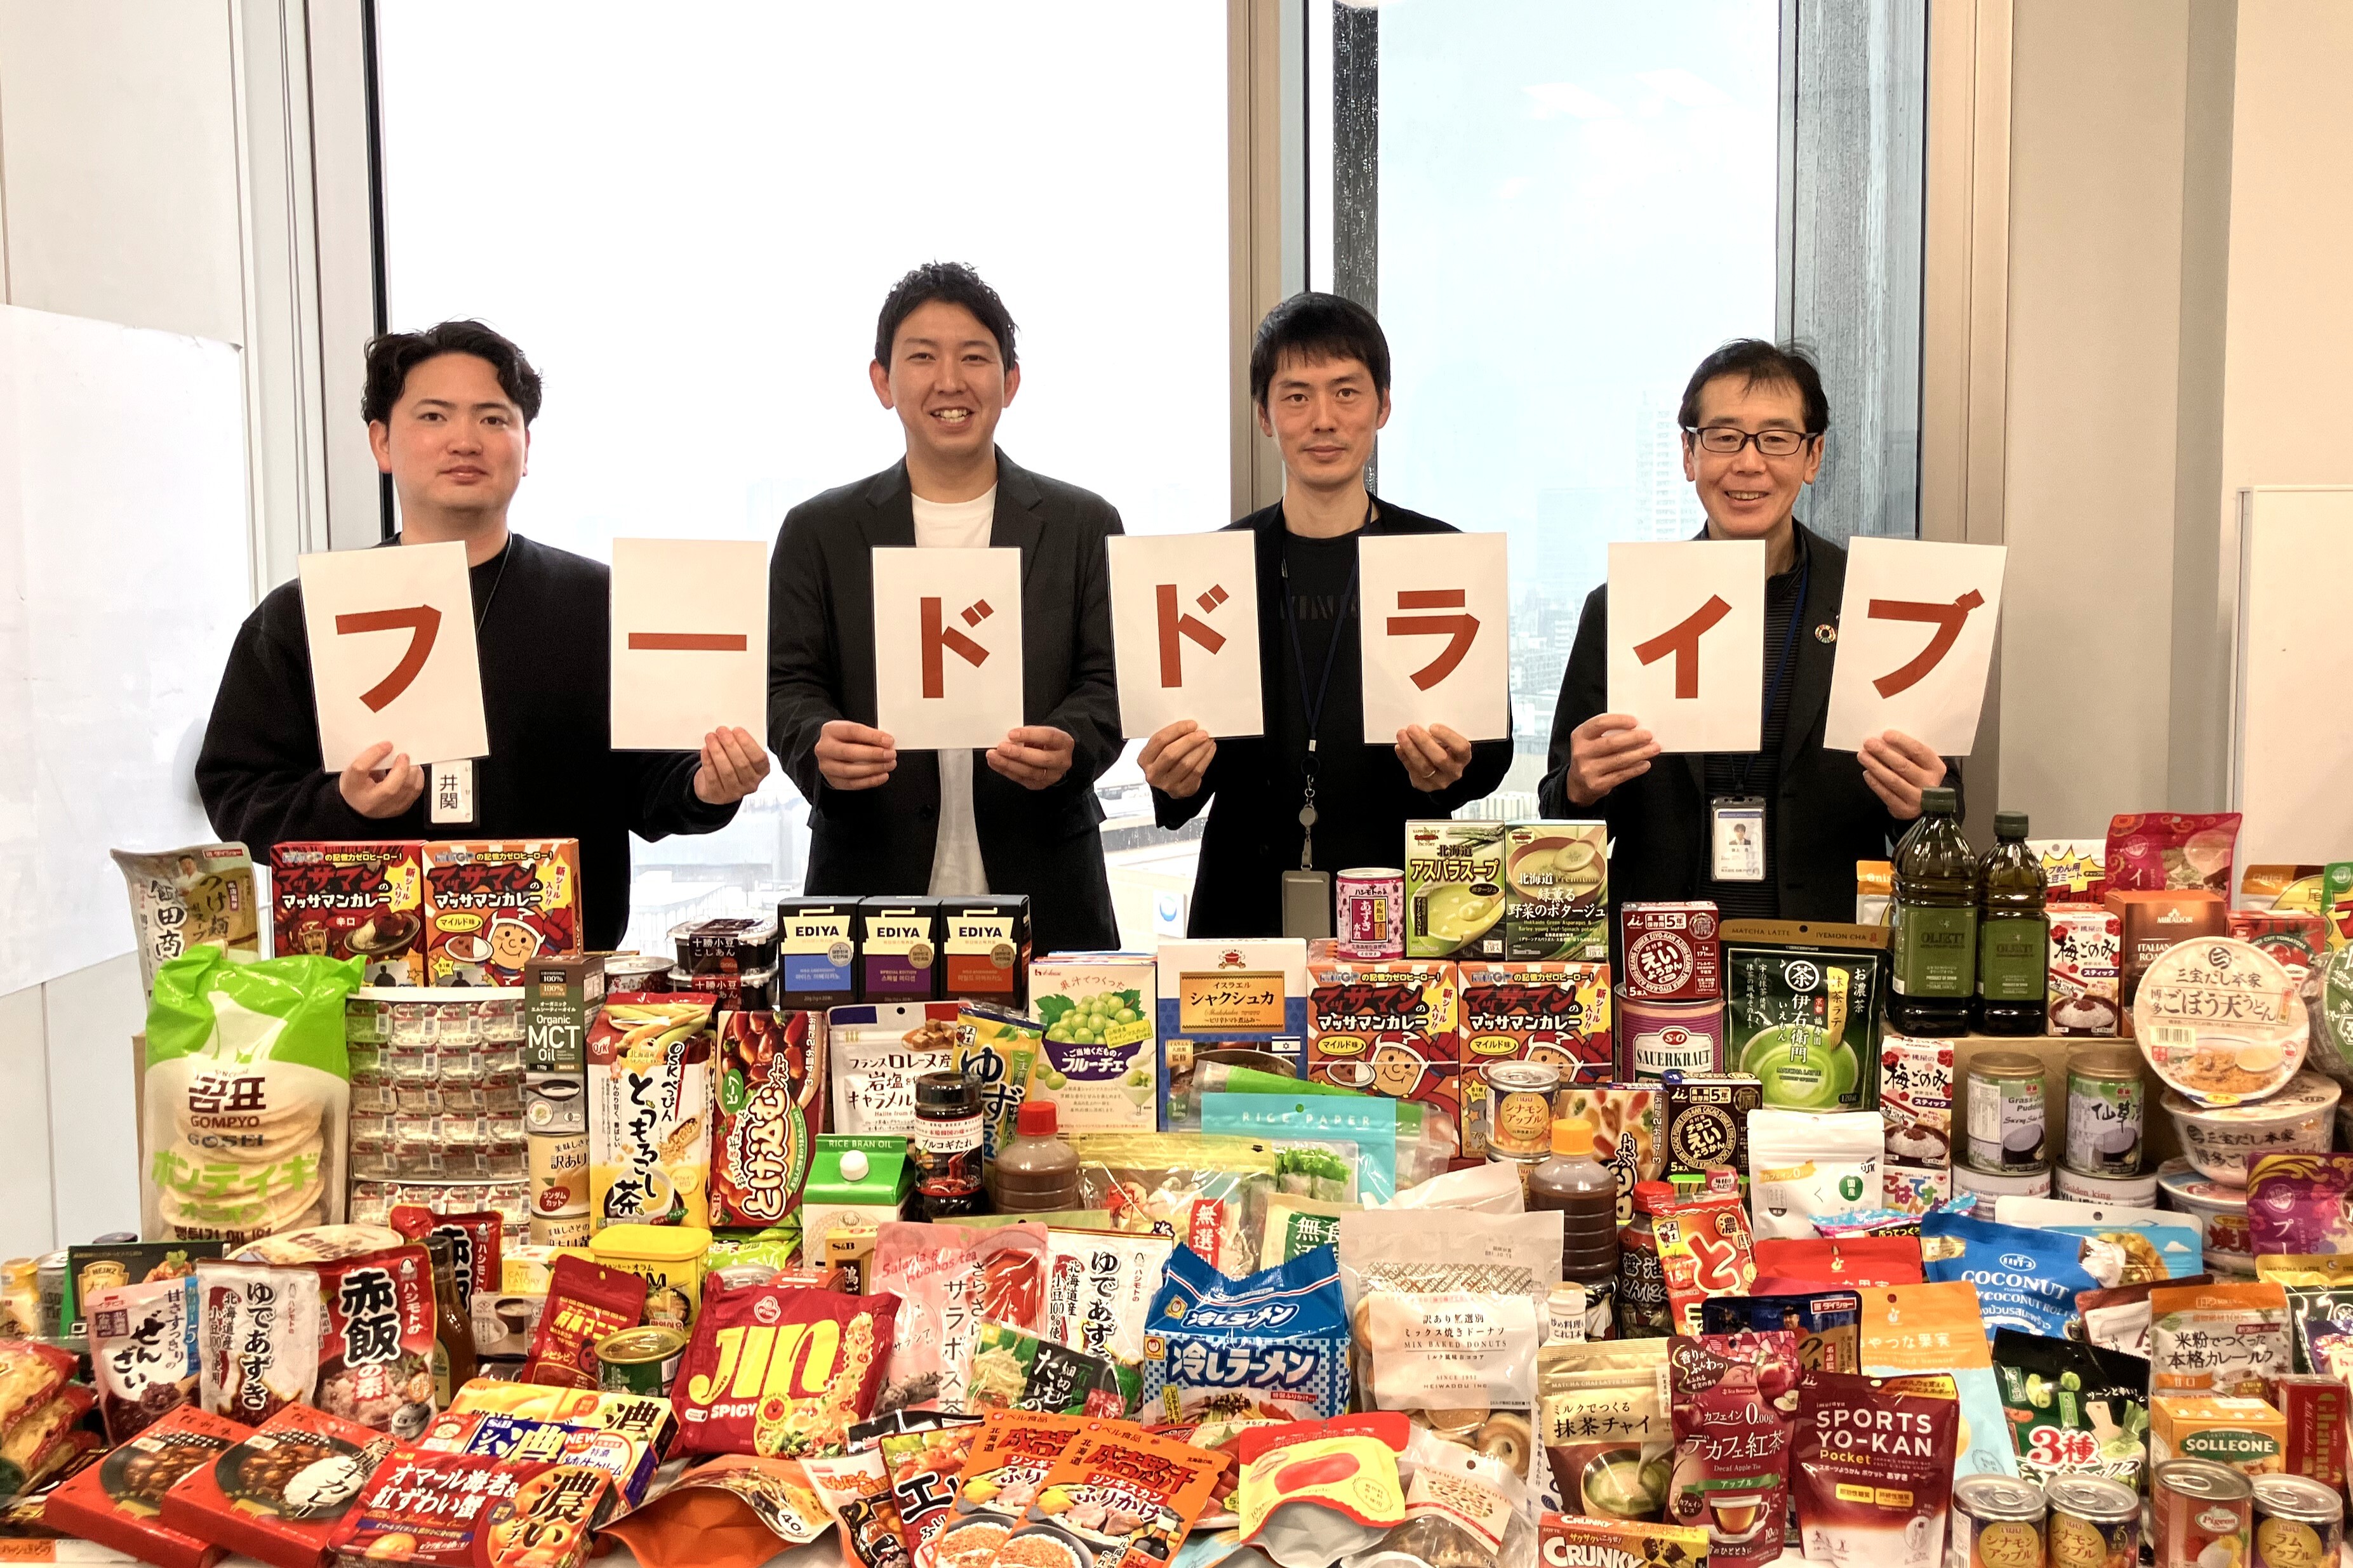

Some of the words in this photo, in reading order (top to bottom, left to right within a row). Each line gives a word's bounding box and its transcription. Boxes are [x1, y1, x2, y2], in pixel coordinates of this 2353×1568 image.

[1156, 583, 1229, 688] ド
[1387, 589, 1480, 692] ラ
[1868, 588, 1985, 699] ブ
[920, 597, 994, 698] ド
[1632, 594, 1732, 699] イ
[335, 604, 442, 713] フ
[439, 774, 458, 811] 井関
[1436, 844, 1473, 858] 北海道
[1410, 859, 1500, 881] アスパラスープ
[1517, 872, 1553, 886] 北海道
[281, 893, 392, 910] マッサマンカレー
[434, 892, 543, 909] マッサマンカレー
[1360, 901, 1372, 932] あずき
[1507, 903, 1606, 919] 野菜のポタージュ
[335, 916, 357, 927] 辛口
[439, 917, 476, 927] マイルド味
[795, 926, 840, 938] EDIYA
[876, 927, 921, 938] EDIYA
[958, 926, 1002, 938] EDIYA
[1731, 928, 1765, 936] MATCHA
[693, 938, 736, 948] 十勝小豆
[2053, 936, 2116, 963] 梅ごのみ
[2137, 943, 2171, 952] ITALIAN
[2276, 935, 2307, 951] TOMATOES
[695, 948, 736, 957] こしあん
[543, 974, 564, 983] 100%
[2083, 968, 2116, 978] スティック
[2176, 967, 2263, 988] 三宝だし本家
[695, 980, 738, 990] 十勝小豆
[1060, 975, 1126, 992] 果汁でつくった
[1213, 981, 1251, 990] イスラエル
[1629, 986, 1648, 997] 5本入
[1853, 967, 1867, 1014] お濃茶
[1190, 992, 1275, 1007] シャクシュカ
[2163, 988, 2277, 1021] ごぼう天うどん
[536, 1014, 571, 1026] Organic
[1317, 1014, 1429, 1032] マッサマンカレー
[1470, 1013, 1582, 1032] マッサマンカレー
[1778, 1000, 1788, 1042] いえもん
[1790, 993, 1811, 1064] 伊右衛門
[528, 1025, 581, 1049] MCT
[1323, 1040, 1359, 1051] マイルド味
[1474, 1040, 1512, 1051] マイルド味
[538, 1049, 556, 1062] Oil
[1069, 1047, 1116, 1058] ご当地くだもの
[1636, 1048, 1710, 1066] SAUERKRAUT
[850, 1053, 952, 1070] フランスロレーヌ産
[1061, 1057, 1127, 1073] フルーチェ
[1883, 1063, 1949, 1091] 梅ごのみ
[726, 1075, 740, 1105] ビーフ
[848, 1090, 914, 1111] キャラメル
[1505, 1103, 1545, 1115] シナモン
[1914, 1098, 1947, 1108] スティック
[2008, 1096, 2033, 1105] Grass
[190, 1115, 260, 1129] GOMPYO
[1242, 1112, 1291, 1124] RICE
[1305, 1113, 1371, 1127] PAPER
[1506, 1113, 1545, 1126] アップル
[1686, 1118, 1714, 1133] チョコ
[828, 1139, 850, 1148] RICE
[851, 1139, 876, 1149] BRAN
[878, 1140, 893, 1149] OIL
[550, 1153, 589, 1170] 訳あり
[1670, 1161, 1690, 1173] 5本入
[542, 1191, 567, 1200] ランダム
[2063, 1183, 2089, 1197] Golden
[2092, 1190, 2112, 1202] king
[545, 1199, 564, 1207] カット
[831, 1242, 855, 1251] S&B
[92, 1263, 117, 1276] HEINZ
[1066, 1261, 1081, 1317] 北海道産
[1131, 1268, 1143, 1303] ハシモトの
[1961, 1270, 2071, 1301] COCONUT
[402, 1282, 424, 1336] ハシモトの
[1822, 1301, 1856, 1310] ダイショー
[222, 1292, 239, 1350] 北海道産
[342, 1272, 398, 1362] 赤飯
[1187, 1305, 1294, 1329] 冷しラーメン
[165, 1289, 186, 1370] 甘さすっきりの
[241, 1282, 276, 1409] ゆであずき
[1404, 1341, 1423, 1349] MIX
[1428, 1340, 1461, 1349] BAKED
[1467, 1339, 1508, 1348] DONUTS
[2175, 1331, 2267, 1349] 米粉でつくった
[1171, 1341, 1316, 1384] 冷しラーメン
[1679, 1349, 1708, 1364] 香りが
[710, 1402, 759, 1419] SPICY
[1553, 1401, 1630, 1415] ミルクでつくる
[1703, 1410, 1743, 1423] カフェイン
[1745, 1402, 1775, 1425] 0.00g
[486, 1418, 513, 1429] S&B
[1553, 1415, 1650, 1438] 抹茶チャイ
[1816, 1409, 1933, 1434] SPORTS
[565, 1432, 597, 1445] NEW
[983, 1427, 1000, 1452] 北海道
[1101, 1425, 1143, 1443] ベル食品
[1069, 1438, 1092, 1466] 北海道
[1686, 1430, 1786, 1461] デカフェ紅茶
[1816, 1430, 1933, 1458] YO-KAN
[2029, 1429, 2097, 1466] 3種
[2185, 1438, 2275, 1453] SOLLEONE
[1820, 1449, 1872, 1465] Pocket
[1422, 1466, 1468, 1487] Natural
[1733, 1464, 1751, 1472] Apple
[1818, 1464, 1861, 1475] スポーツようかん
[1862, 1470, 1885, 1478] ポケット
[1092, 1473, 1164, 1503] ジンギスカン
[1720, 1478, 1753, 1488] アップル
[370, 1485, 486, 1522] 紅ずわい蟹
[1076, 1485, 1163, 1525] ふりかけ
[1678, 1499, 1703, 1509] カフェイン
[1560, 1515, 1614, 1528] CRUNKY
[1569, 1533, 1623, 1545] サクサクいこうぜ!
[1985, 1534, 2034, 1548] シナモン
[2052, 1527, 2098, 1546] シナモン
[2276, 1532, 2303, 1547] ラム
[1542, 1536, 1645, 1568] CRUNKY
[1989, 1546, 2032, 1560] アップル
[2053, 1539, 2095, 1560] アップル
[2263, 1543, 2311, 1561] アップル
